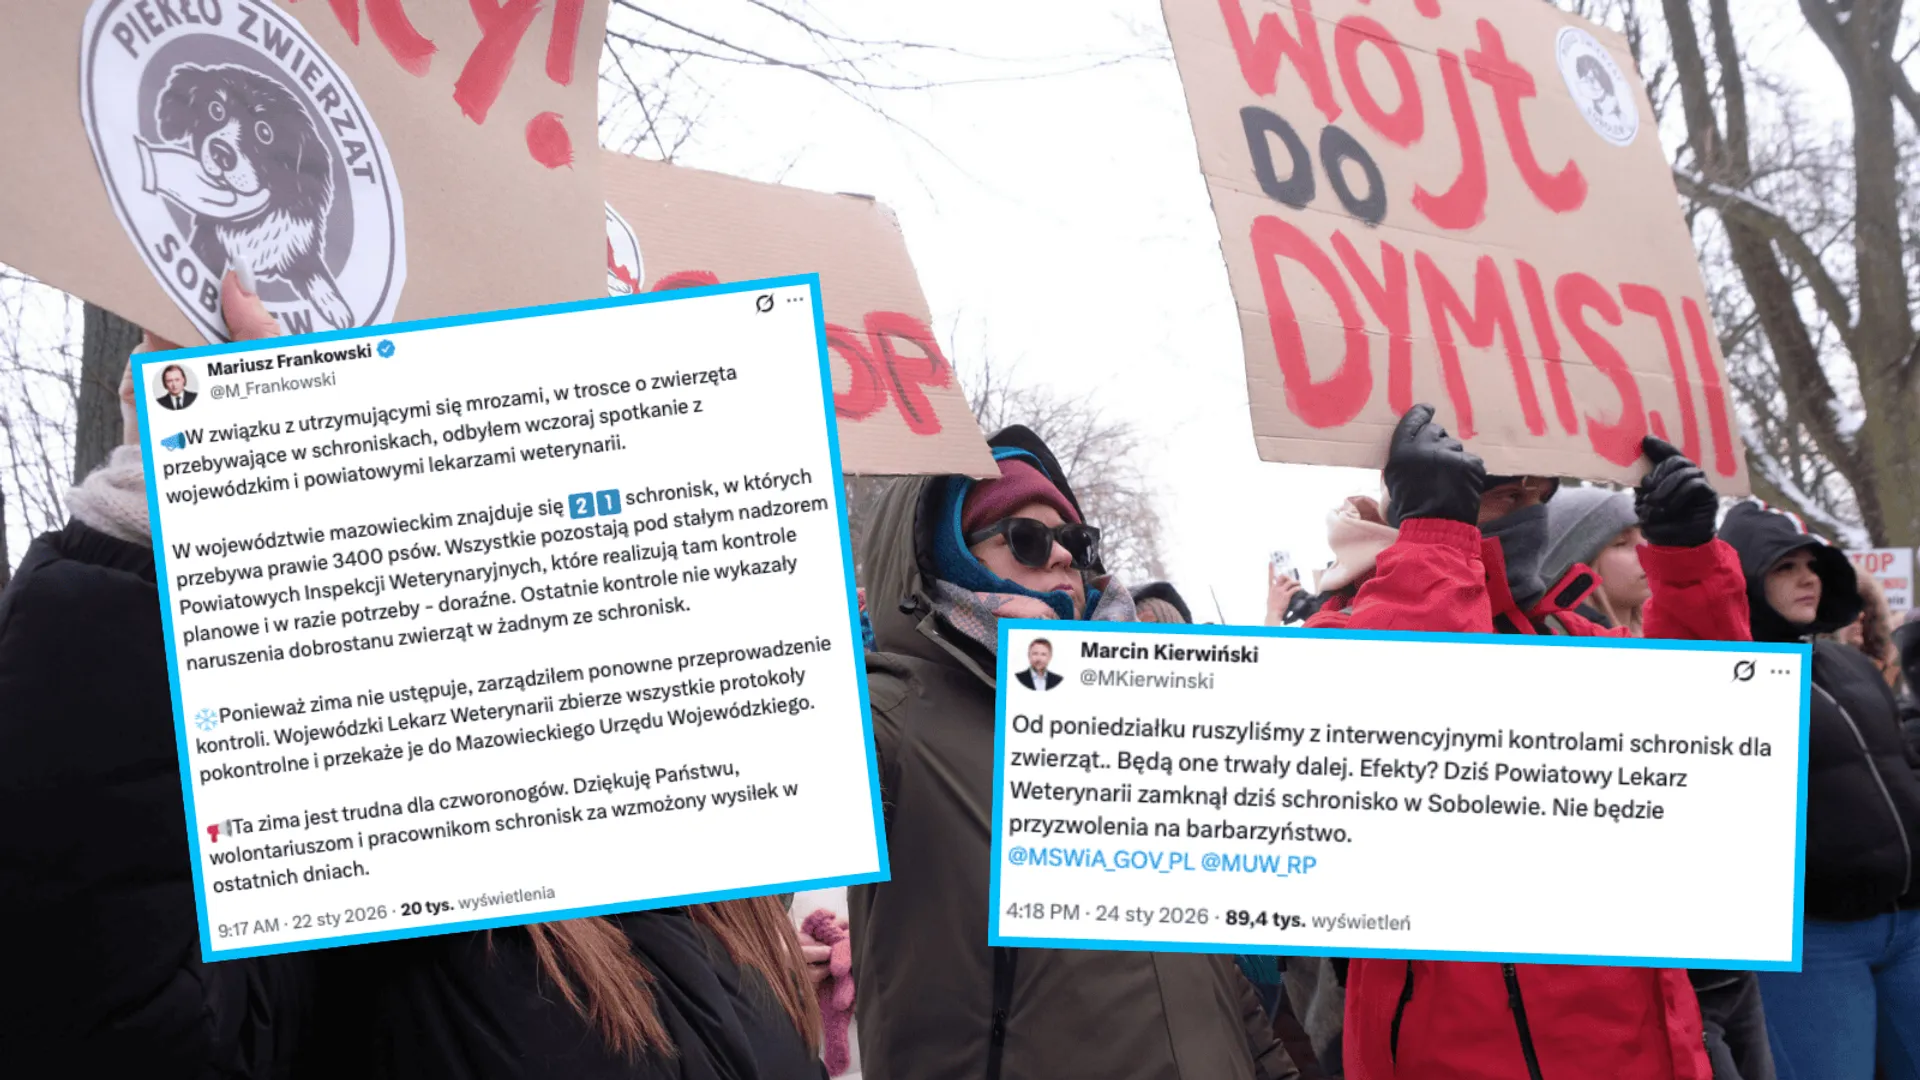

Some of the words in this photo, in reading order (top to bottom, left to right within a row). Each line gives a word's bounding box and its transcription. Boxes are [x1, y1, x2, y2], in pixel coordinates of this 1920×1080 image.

[111, 0, 222, 60] PIEKŁO
[1240, 108, 1387, 226] DO
[1250, 215, 1737, 478] DYMISJI
[1852, 553, 1895, 573] TOP
